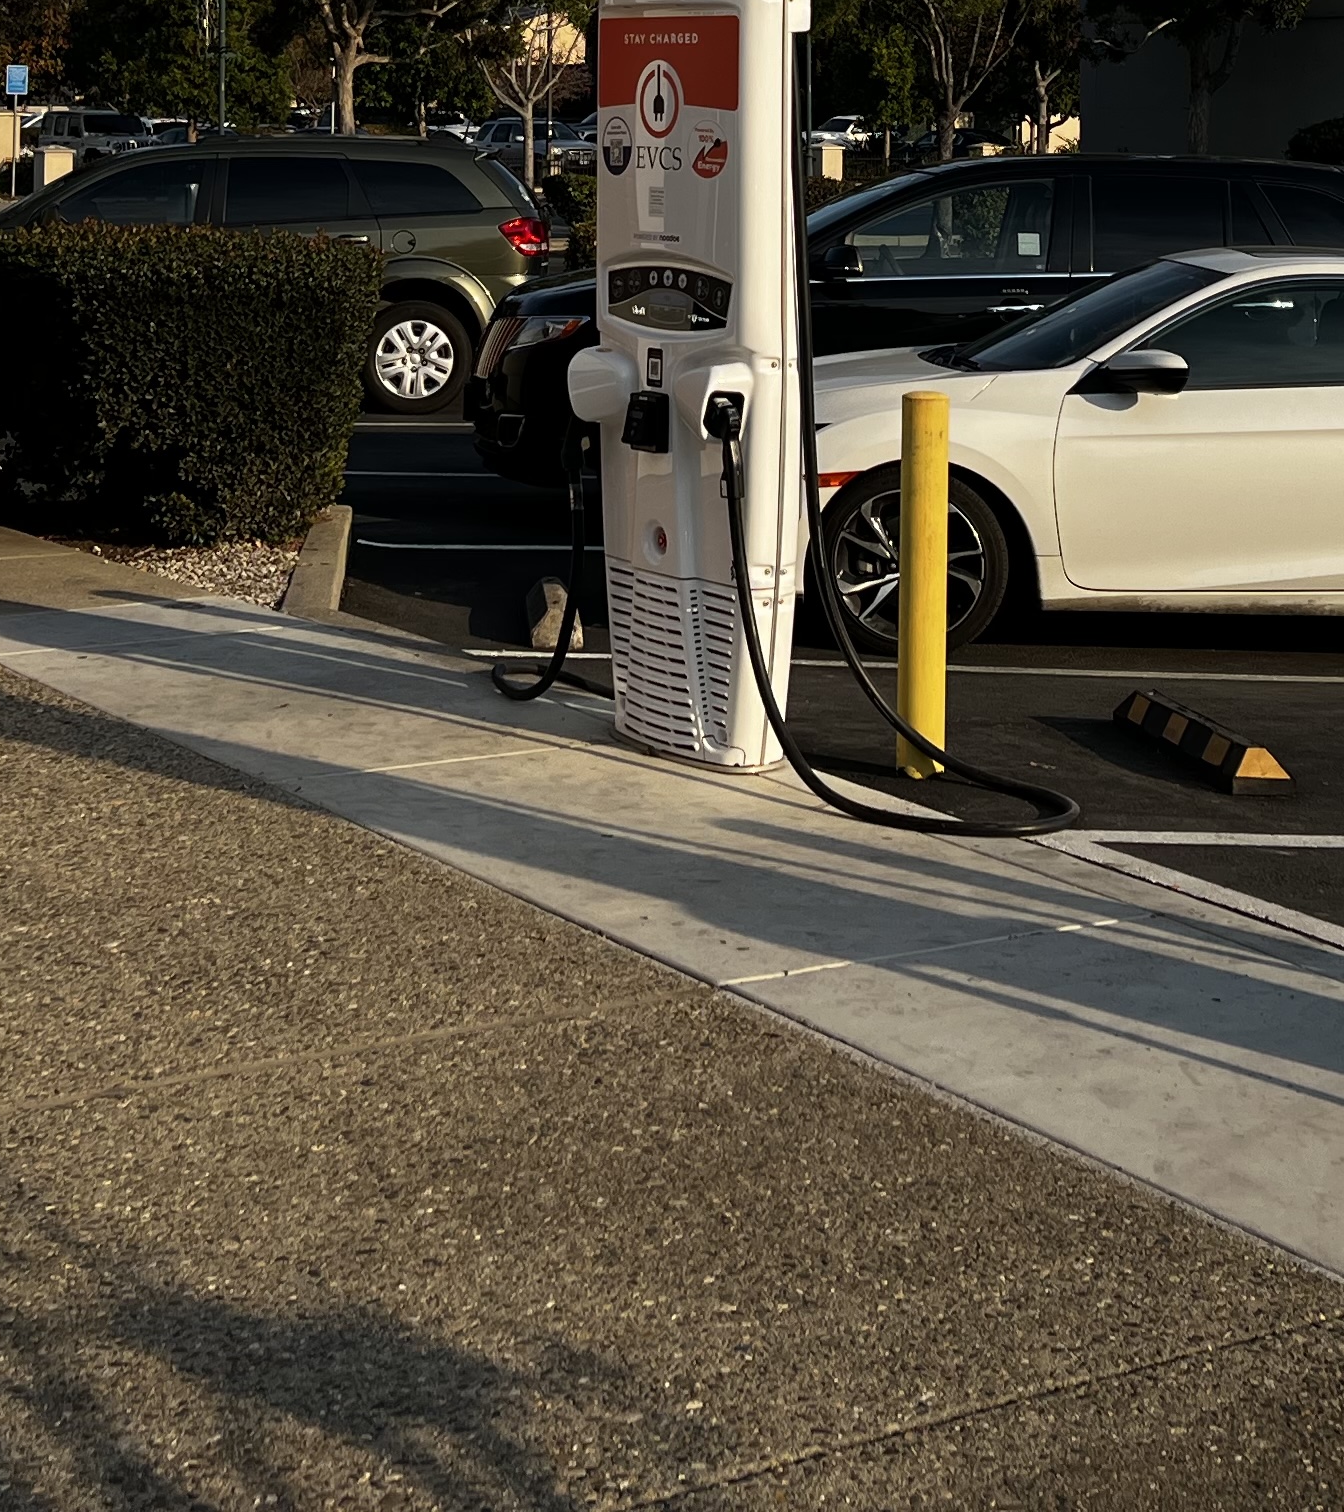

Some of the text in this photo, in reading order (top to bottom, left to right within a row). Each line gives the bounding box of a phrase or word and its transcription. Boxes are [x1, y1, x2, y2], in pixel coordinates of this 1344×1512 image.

[624, 33, 699, 45] STAY CHARGED
[636, 145, 682, 171] EVCS
